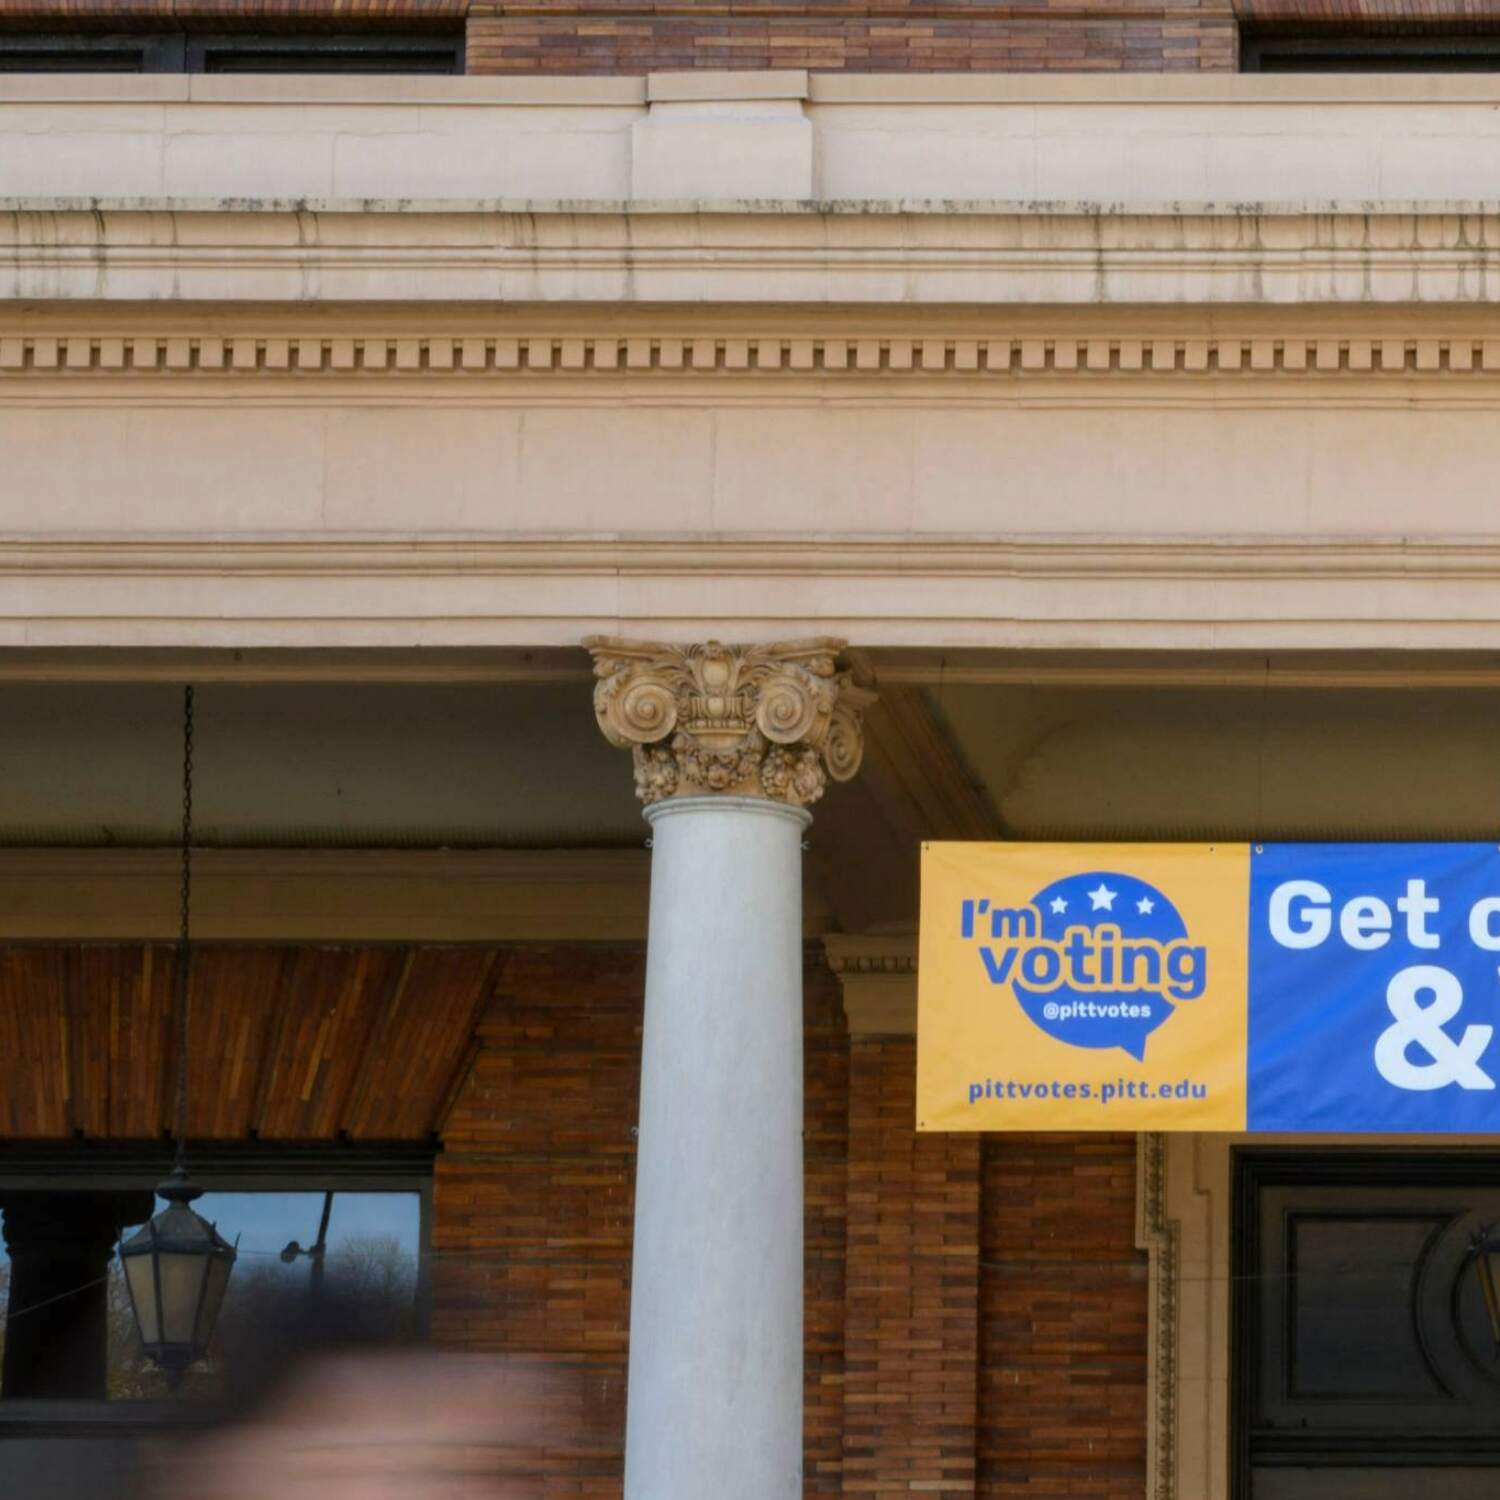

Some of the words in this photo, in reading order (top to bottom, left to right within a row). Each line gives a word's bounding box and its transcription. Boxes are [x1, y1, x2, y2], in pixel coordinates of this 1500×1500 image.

[1269, 880, 1440, 950] Get
[979, 928, 1207, 1000] voting
[1043, 1002, 1151, 1020] @pittvotes
[969, 1079, 1207, 1104] pittvotes.pitt.edu
